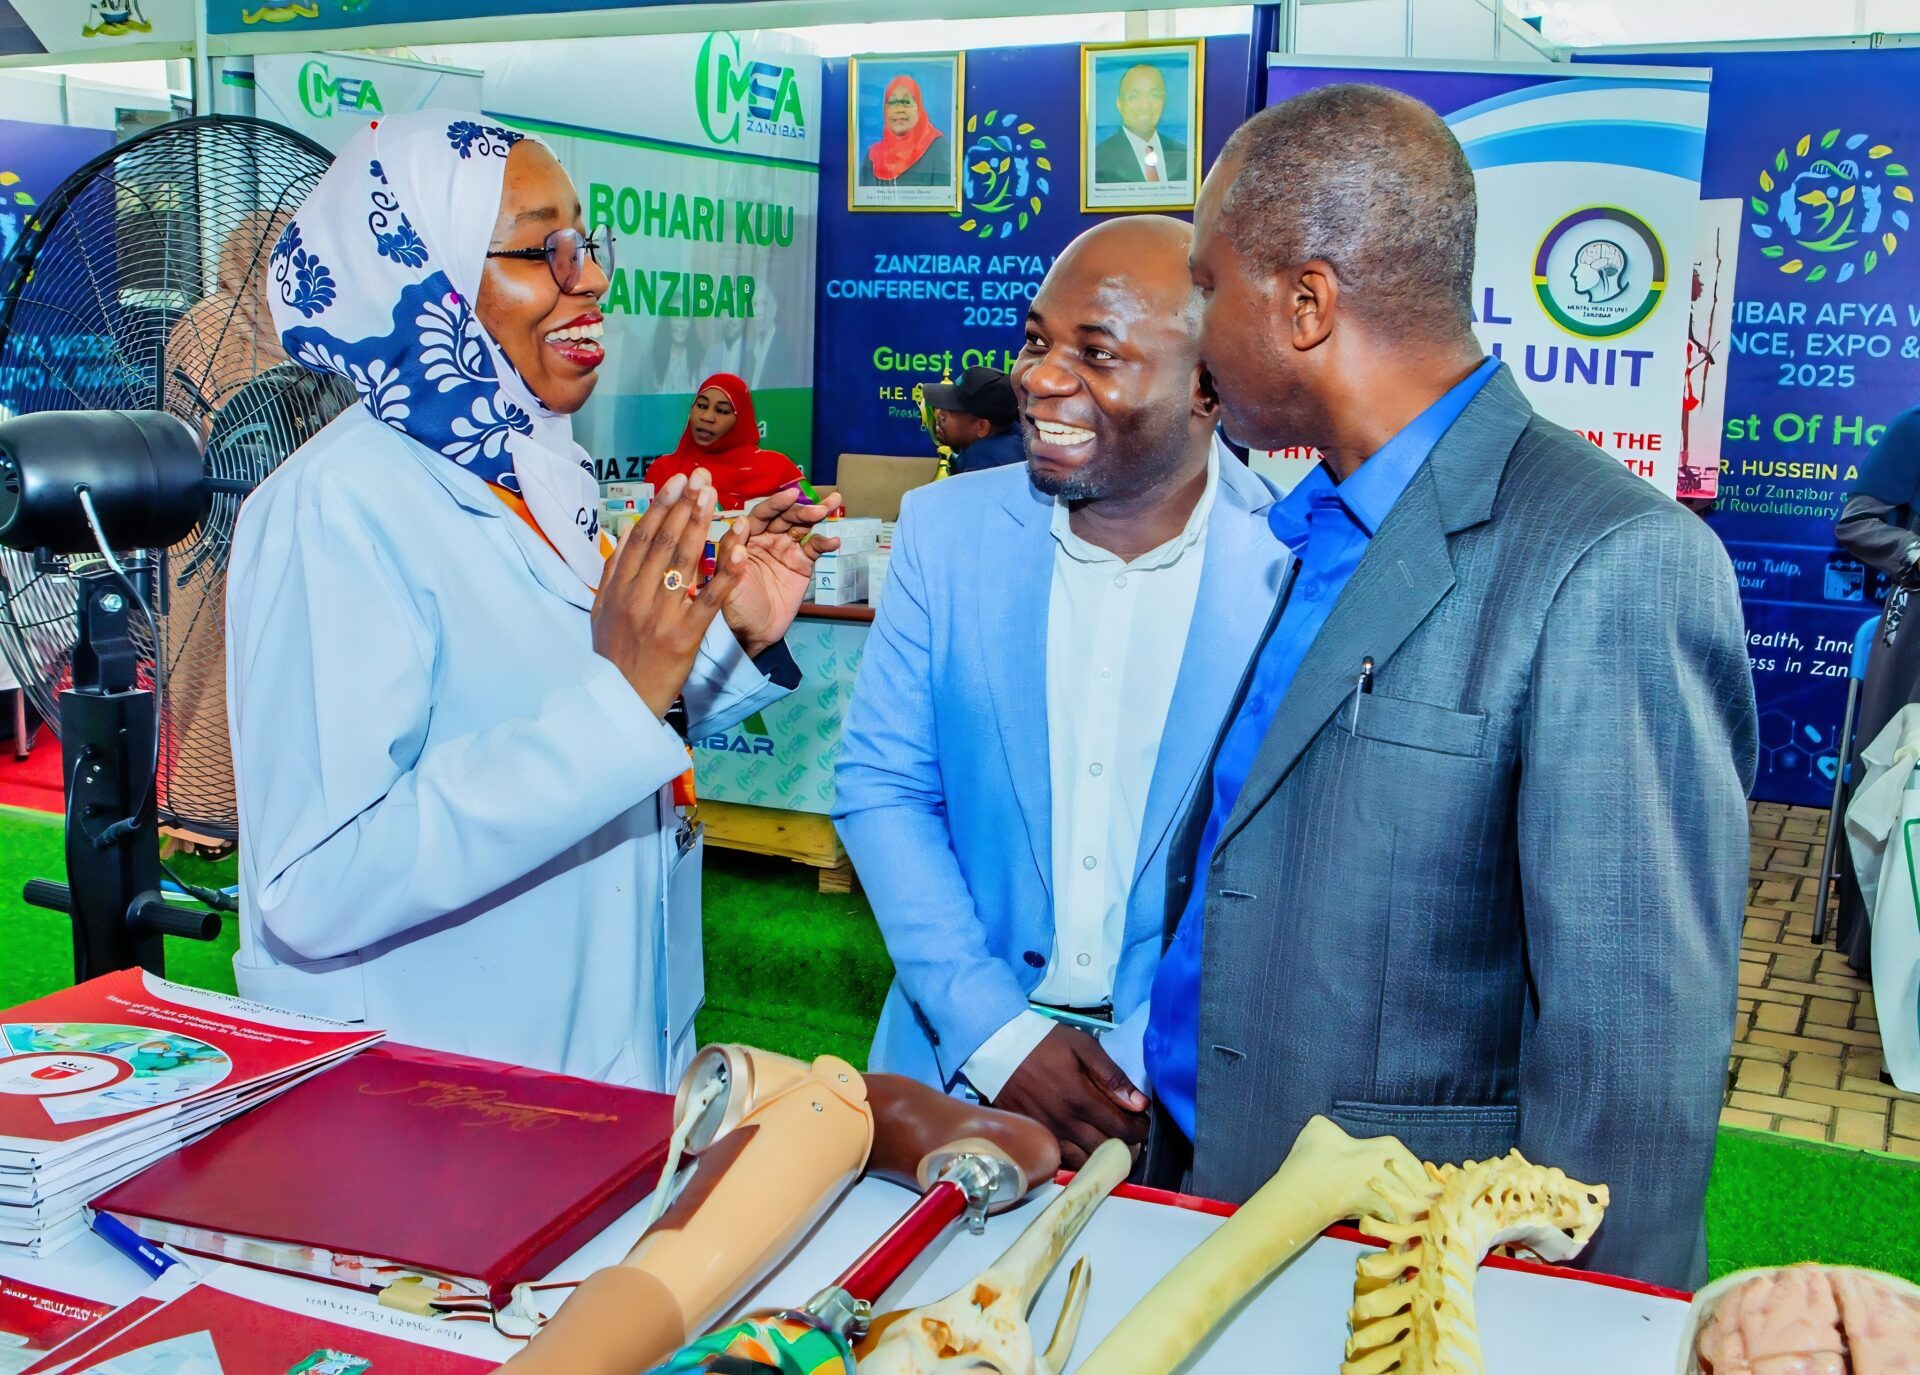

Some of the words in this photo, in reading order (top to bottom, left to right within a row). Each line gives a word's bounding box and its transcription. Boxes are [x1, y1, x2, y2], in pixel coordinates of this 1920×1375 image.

[590, 182, 725, 242] BOHARI
[736, 200, 794, 247] KUU
[874, 254, 981, 275] ZANZIBAR
[987, 255, 1045, 275] AFYA
[601, 267, 756, 318] ANZIBAR
[827, 280, 976, 303] CONFERENCE,
[982, 281, 1041, 301] EXPO
[963, 306, 1018, 327] 2025
[1815, 303, 1898, 327] AFYA
[1806, 333, 1892, 359] EXPO
[873, 346, 953, 373] Guest
[1525, 344, 1655, 387] UNIT
[1778, 363, 1855, 388] 2025
[880, 386, 908, 401] H.E.
[1773, 412, 1824, 445] Of
[1613, 432, 1662, 451] THE
[1742, 460, 1838, 481] HUSSEIN
[1745, 484, 1761, 496] of
[1766, 484, 1834, 502] Zanzibar
[1731, 498, 1839, 521] Revolutionary
[1763, 558, 1801, 577] Tulip,
[1785, 656, 1801, 674] in
[1810, 660, 1849, 678] Zan
[126, 1008, 149, 1016] and
[147, 1011, 185, 1025] Trauma
[144, 1004, 161, 1013] the
[160, 1008, 178, 1017] Art
